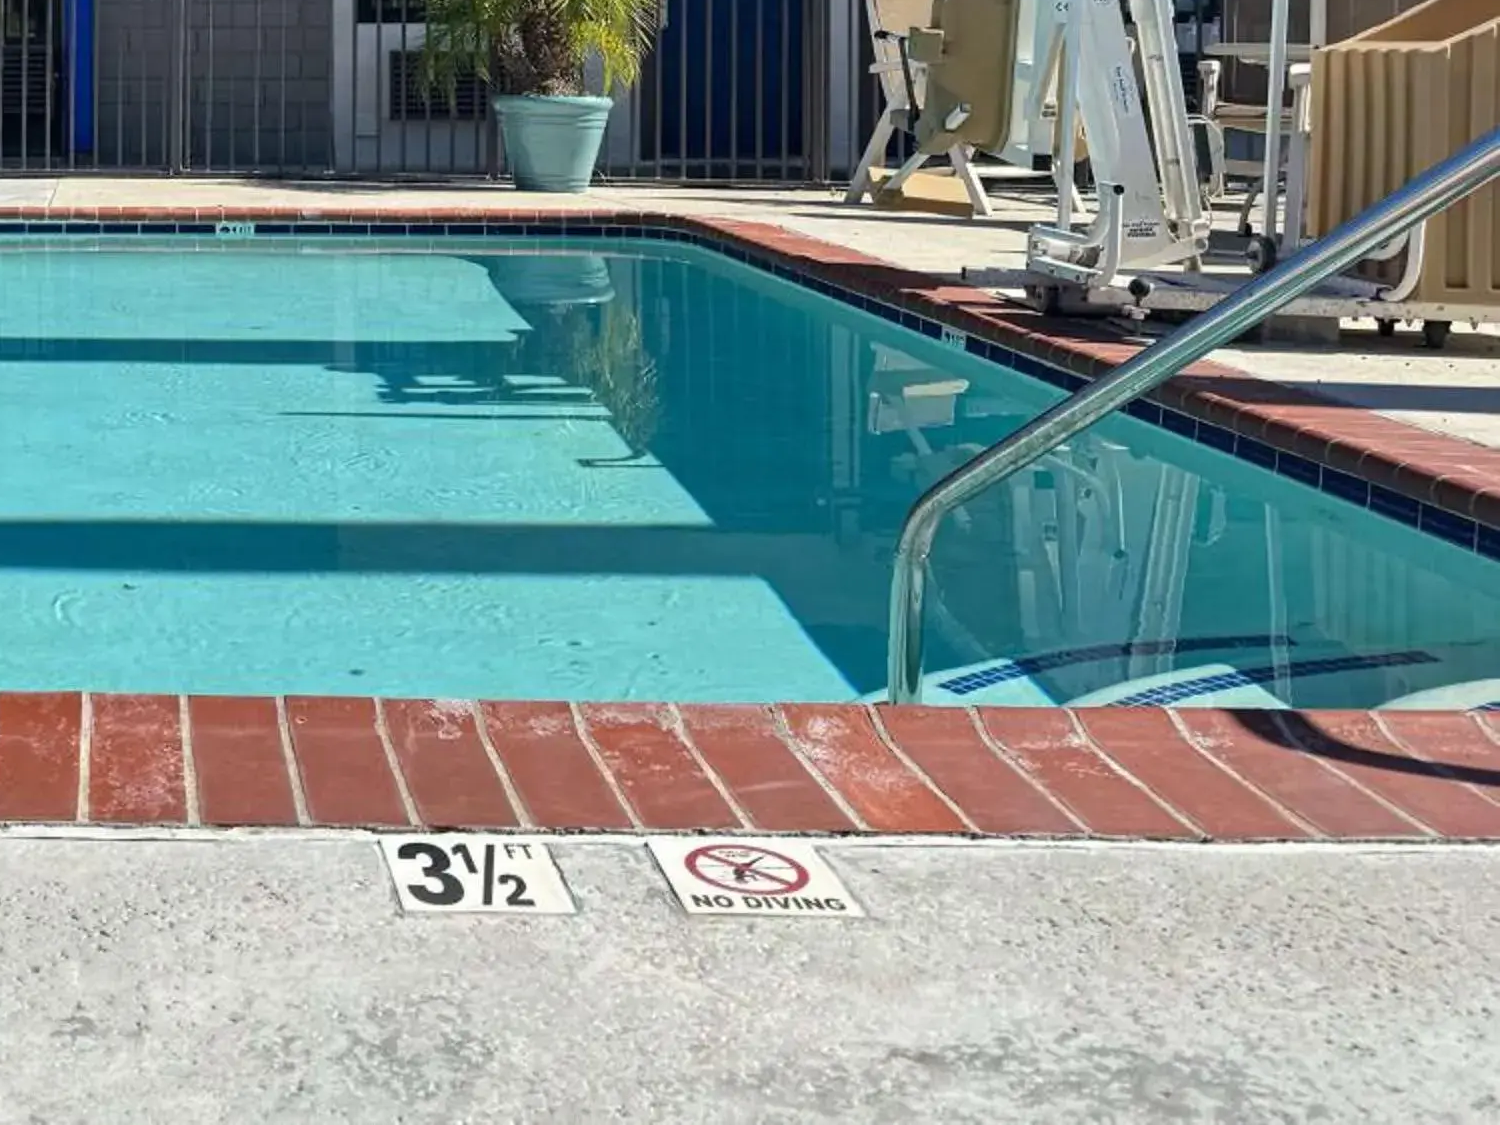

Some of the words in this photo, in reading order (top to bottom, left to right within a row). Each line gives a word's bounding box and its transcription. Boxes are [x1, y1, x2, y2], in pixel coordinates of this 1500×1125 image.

[503, 842, 533, 860] FT
[691, 893, 734, 908] NO
[743, 895, 847, 911] DIVING
